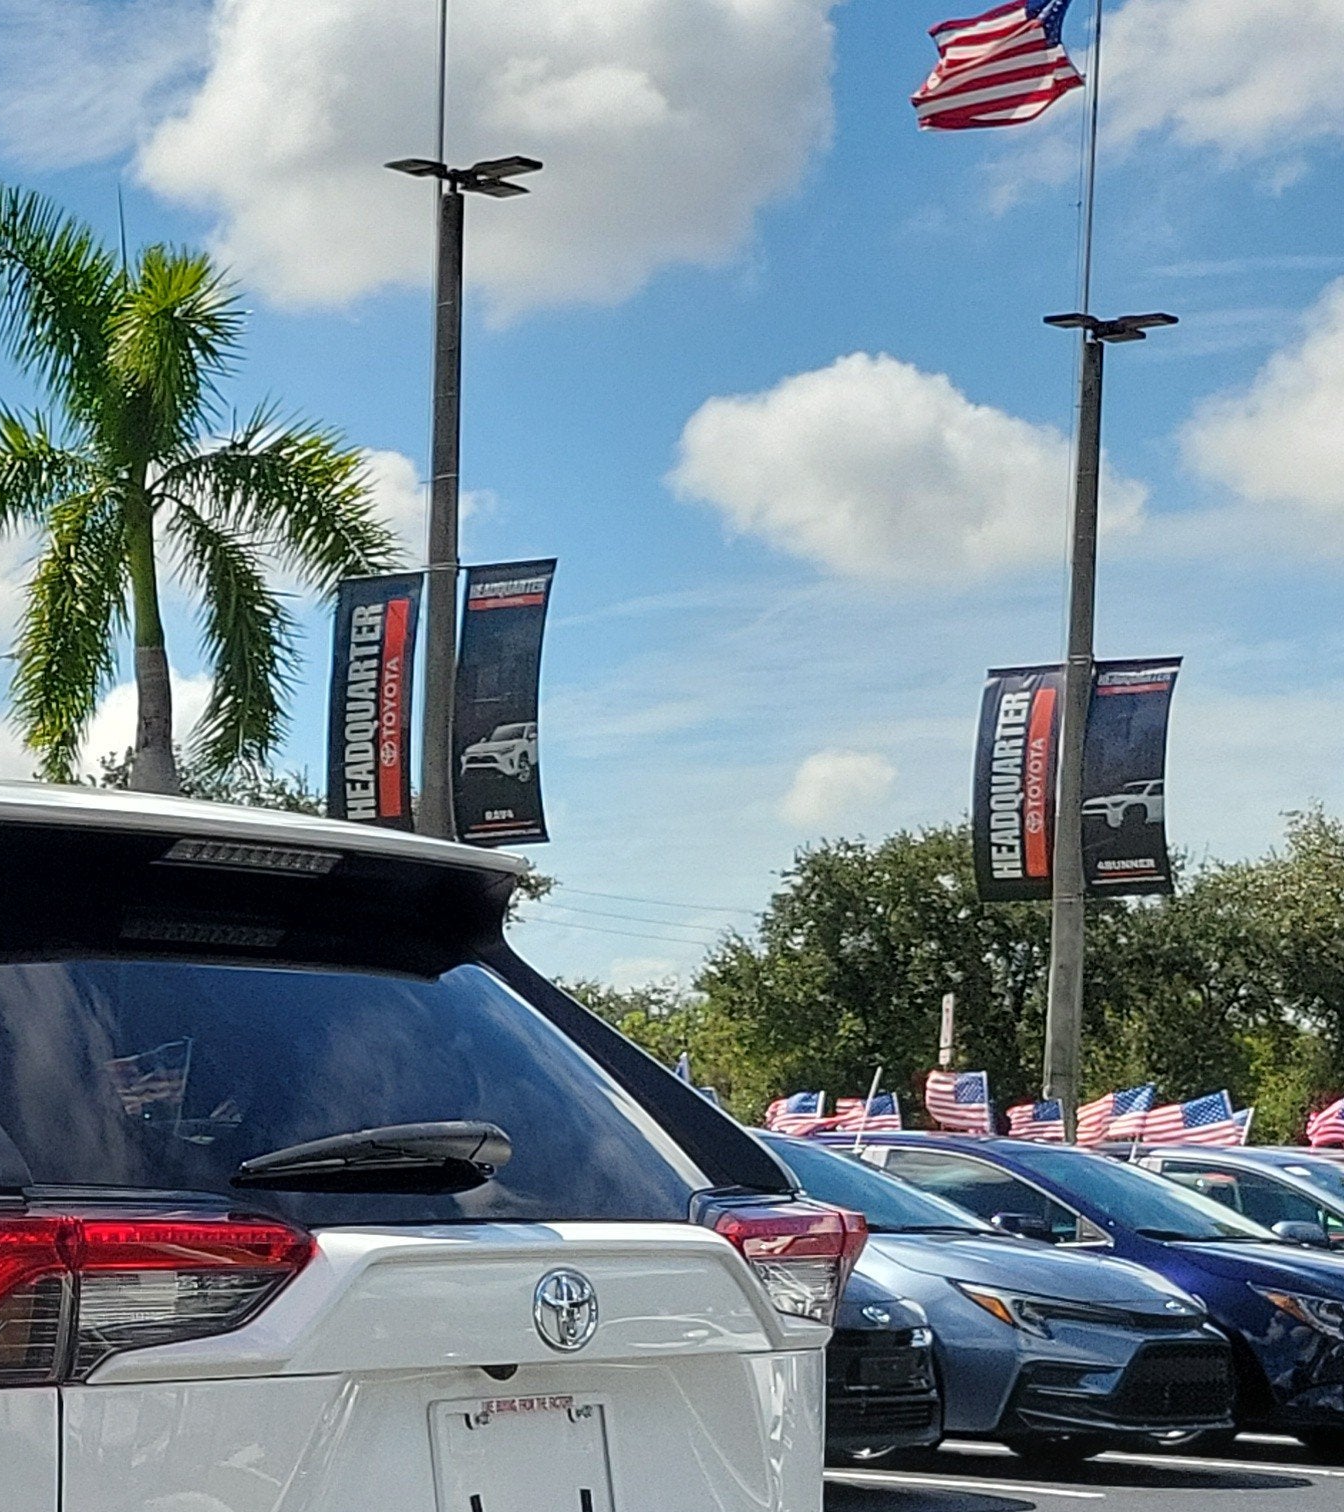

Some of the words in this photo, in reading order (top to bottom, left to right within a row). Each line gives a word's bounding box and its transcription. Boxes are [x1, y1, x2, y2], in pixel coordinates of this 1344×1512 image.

[345, 602, 384, 819] HEADQUARTER
[383, 656, 399, 738] TOYOTA
[990, 691, 1031, 879] HEADQUARTER
[1028, 737, 1046, 807] TOYOTA
